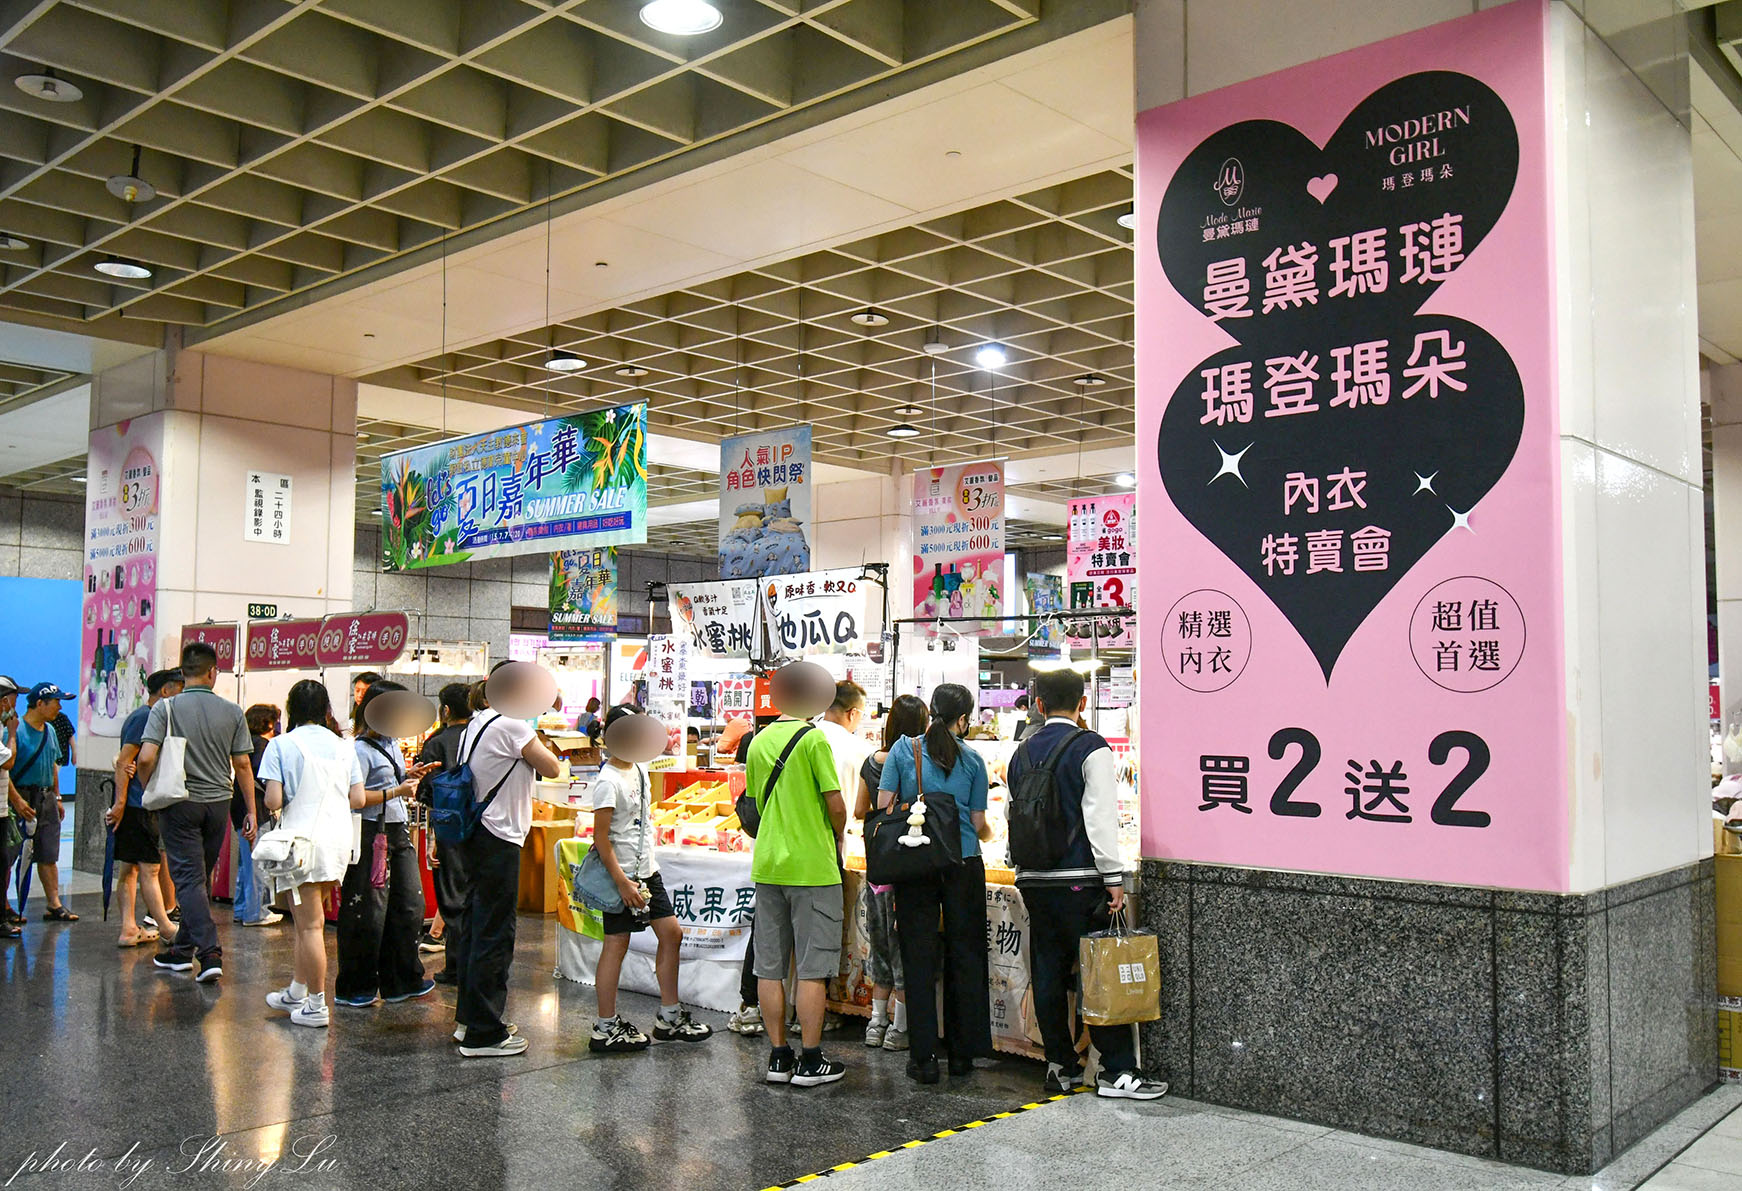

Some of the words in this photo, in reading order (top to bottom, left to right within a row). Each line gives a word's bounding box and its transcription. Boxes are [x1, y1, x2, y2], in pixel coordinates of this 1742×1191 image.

[1365, 104, 1471, 150] MODERN
[1389, 137, 1446, 167] GIRL
[1382, 163, 1455, 192] 瑪登瑪朵
[1200, 212, 1229, 229] Mode
[1231, 206, 1263, 222] Marie
[1202, 217, 1260, 243] 曼黛瑪璉
[1203, 212, 1465, 322] 曼黛瑪璉
[1200, 329, 1468, 427] 瑪登瑪朵
[740, 444, 793, 469] 人氣IP
[456, 425, 580, 546] 夏日嘉年華
[726, 462, 804, 491] 角色快閃祭
[1284, 466, 1368, 516] 內衣
[253, 488, 264, 536] 監視錄影中
[273, 491, 284, 539] 二十四小時
[525, 493, 587, 520] SUMMER
[589, 486, 627, 511] SALE
[431, 504, 450, 537] go
[920, 516, 999, 537] 滿3000元現折300元
[920, 534, 999, 555] 滿5000元現折600元
[1098, 534, 1124, 551] 美妝
[1260, 525, 1392, 576] 特賣會
[1091, 551, 1130, 567] 特賣會
[552, 612, 591, 624] SUMMER
[591, 614, 614, 624] SALE
[1178, 610, 1232, 639] 精選
[1431, 600, 1500, 632] 超值
[691, 621, 752, 654] 水蜜桃
[659, 639, 675, 691] 水蜜桃
[1179, 646, 1232, 674] 內衣
[1431, 640, 1501, 672] 首選
